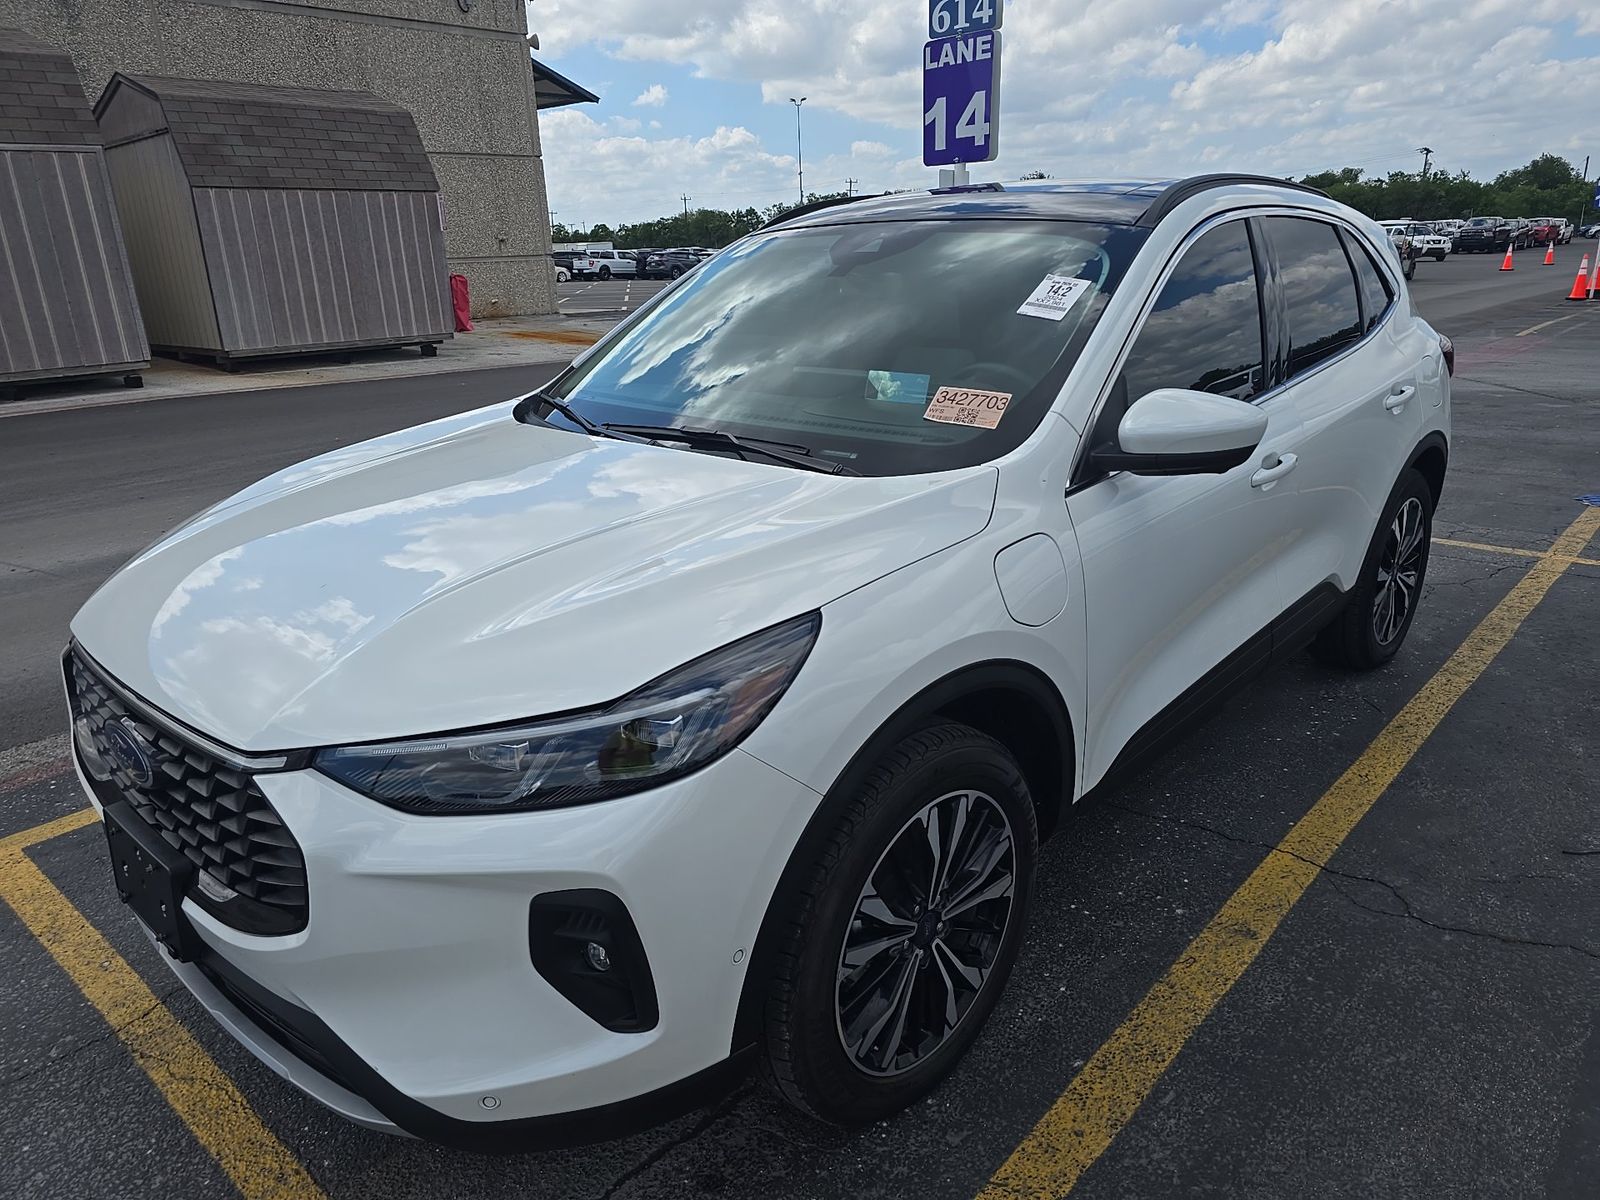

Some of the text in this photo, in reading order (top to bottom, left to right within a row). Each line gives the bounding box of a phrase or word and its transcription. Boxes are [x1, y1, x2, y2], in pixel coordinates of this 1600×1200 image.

[932, 0, 993, 33] 614
[925, 35, 992, 70] LANE
[925, 90, 990, 151] 14
[936, 390, 1008, 410] 3427703
